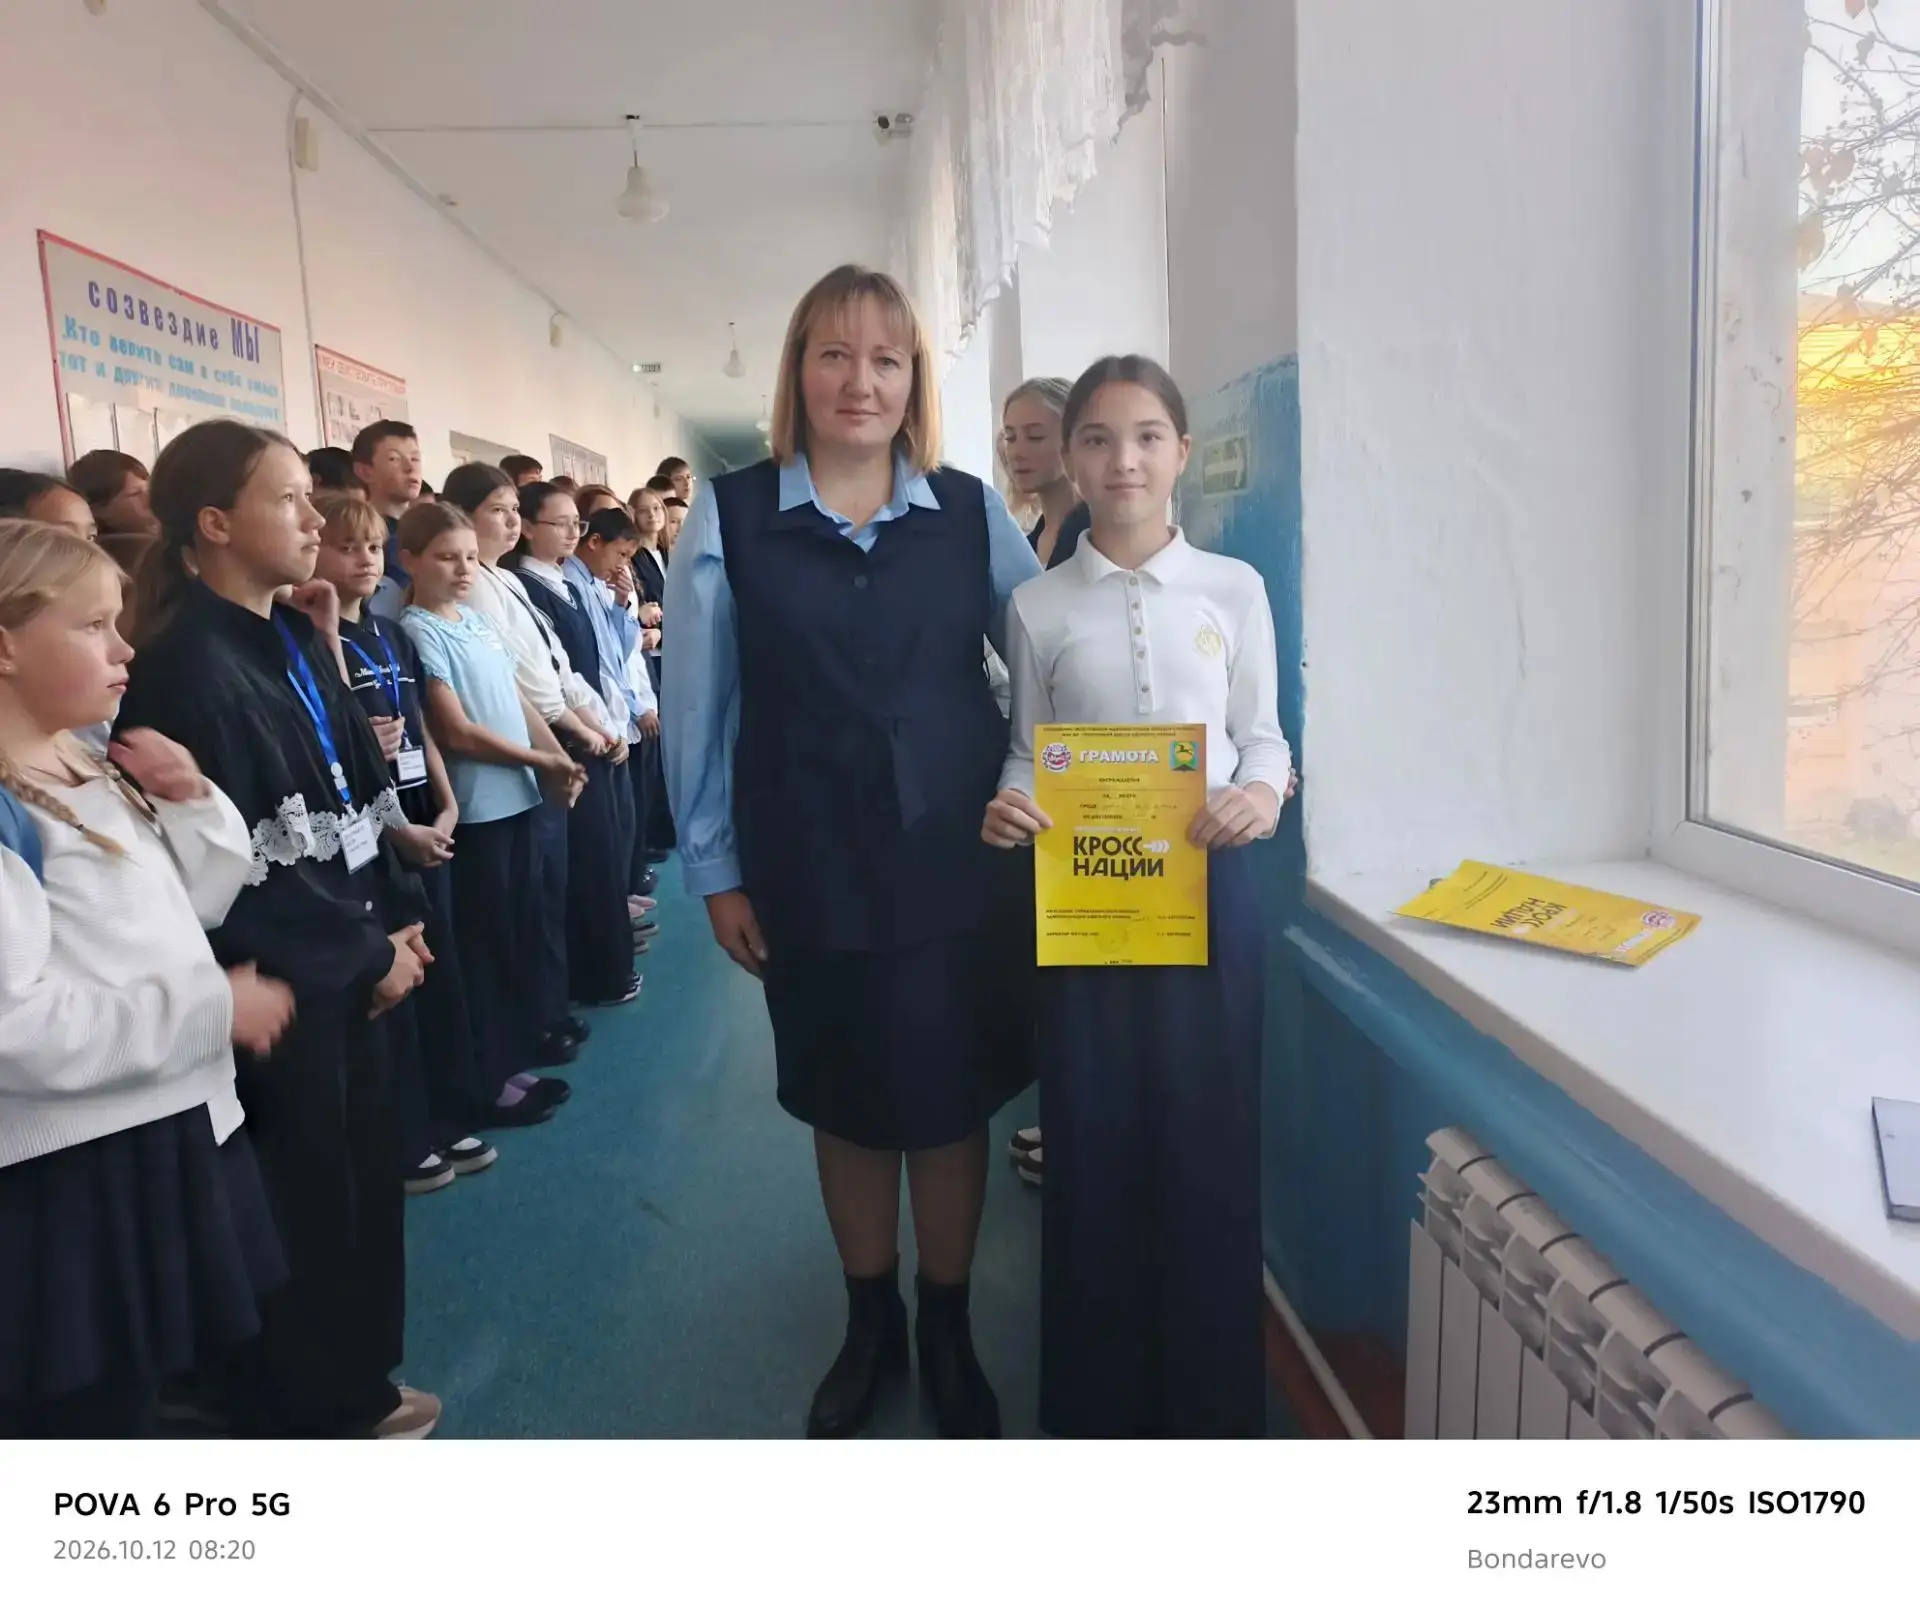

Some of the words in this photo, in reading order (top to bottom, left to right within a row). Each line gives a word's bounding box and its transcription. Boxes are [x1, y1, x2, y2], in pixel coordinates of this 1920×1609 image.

[230, 318, 260, 363] МЫ
[1079, 749, 1159, 764] ГРАМОТА
[1073, 835, 1143, 856] КРОСС
[1073, 857, 1164, 881] НАЦИИ
[1489, 896, 1546, 929] НАЦИИ
[1520, 901, 1568, 928] КРОСС
